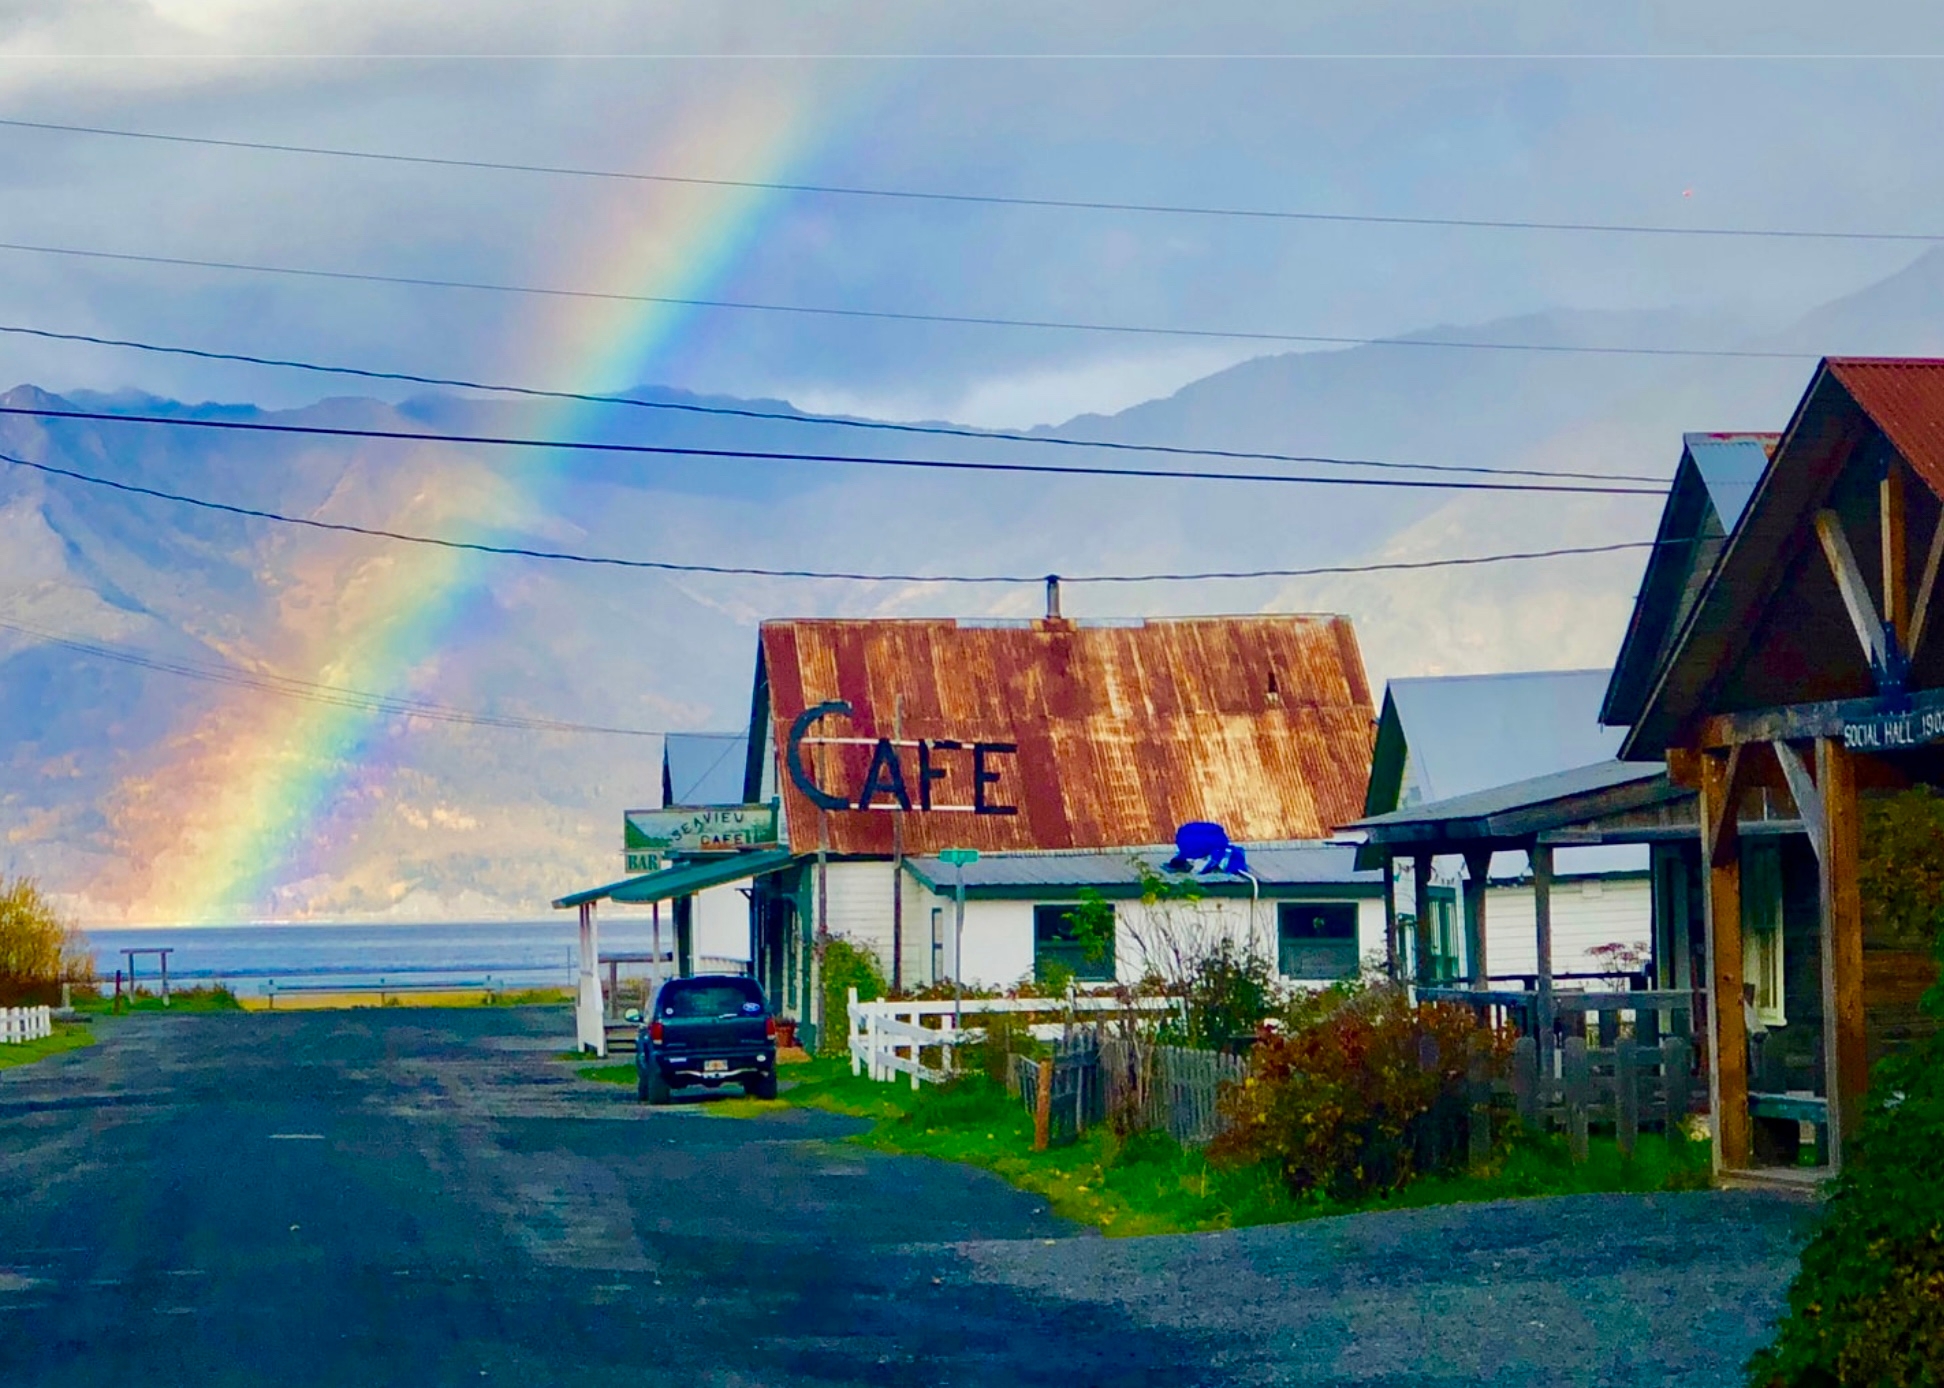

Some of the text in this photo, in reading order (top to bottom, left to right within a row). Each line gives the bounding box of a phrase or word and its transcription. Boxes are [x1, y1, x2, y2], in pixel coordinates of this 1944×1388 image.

[1844, 723, 1880, 747] SOCIAL
[1884, 720, 1915, 745] HALL
[787, 700, 1018, 815] CAFE
[700, 834, 743, 845] CAFE
[628, 854, 659, 871] BAR
